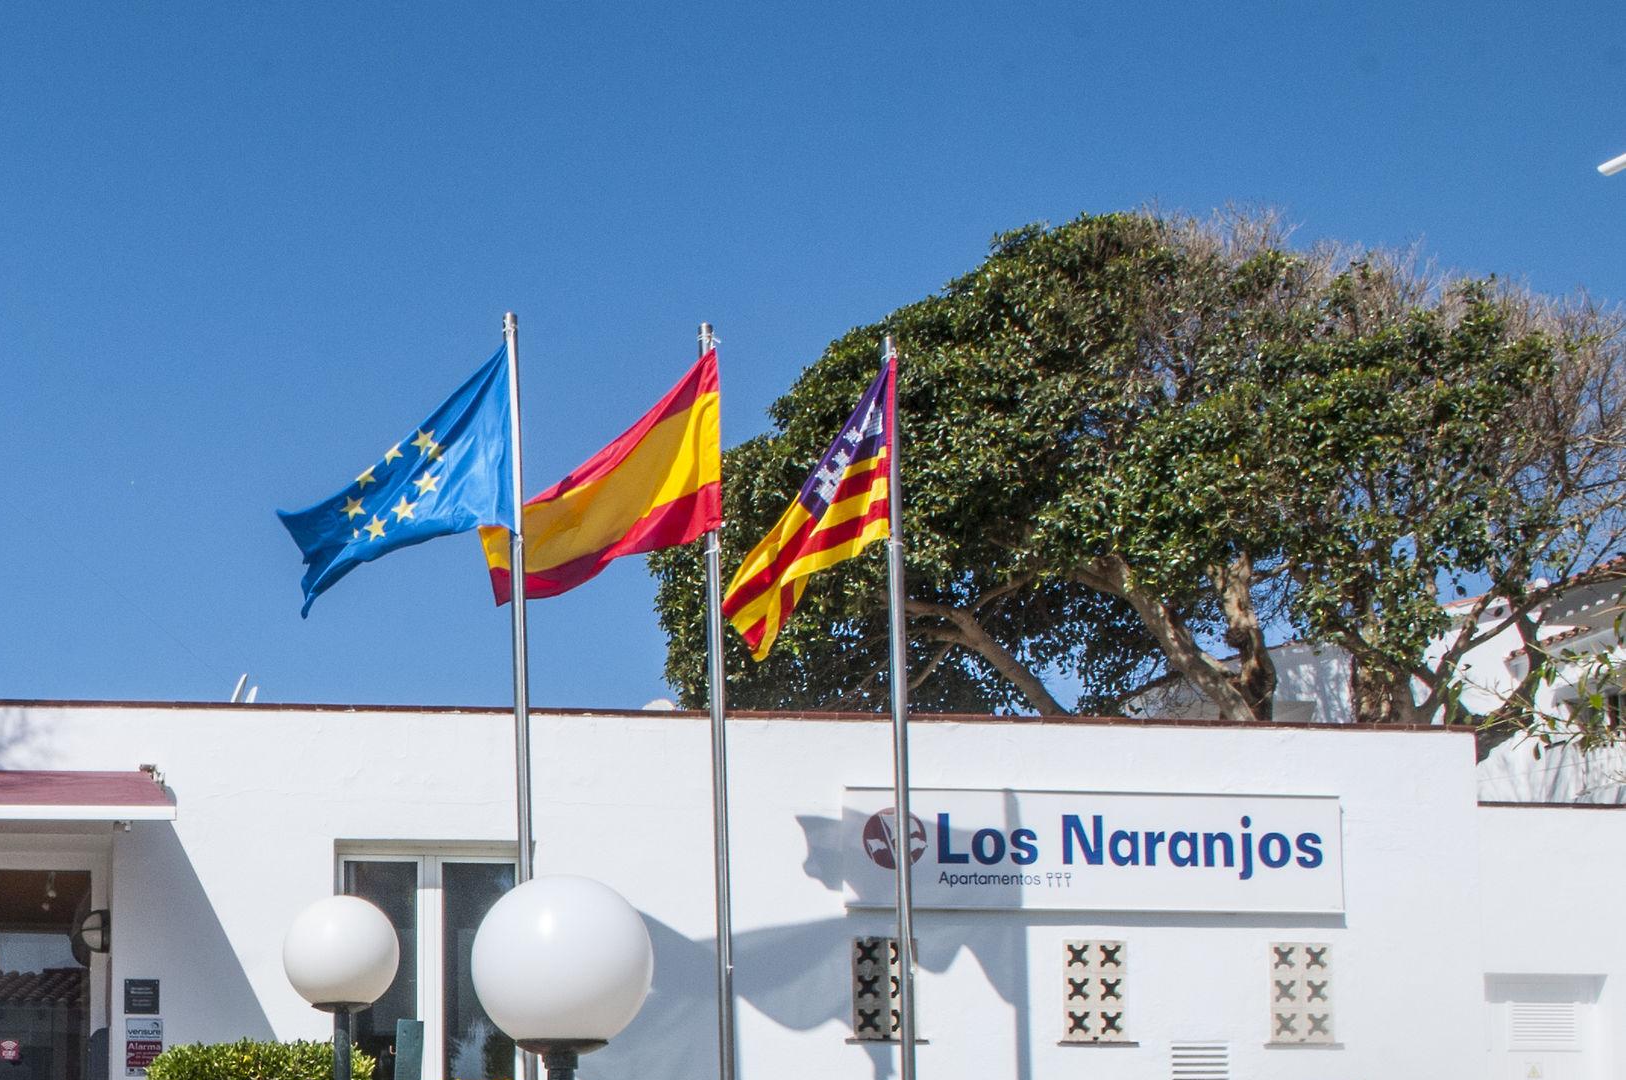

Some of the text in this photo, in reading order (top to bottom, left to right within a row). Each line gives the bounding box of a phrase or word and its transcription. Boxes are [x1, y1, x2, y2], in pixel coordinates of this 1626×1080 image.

[936, 813, 1323, 880] Los Naranjos
[938, 871, 1041, 887] Apartamentos
[127, 1042, 162, 1050] Alarma
